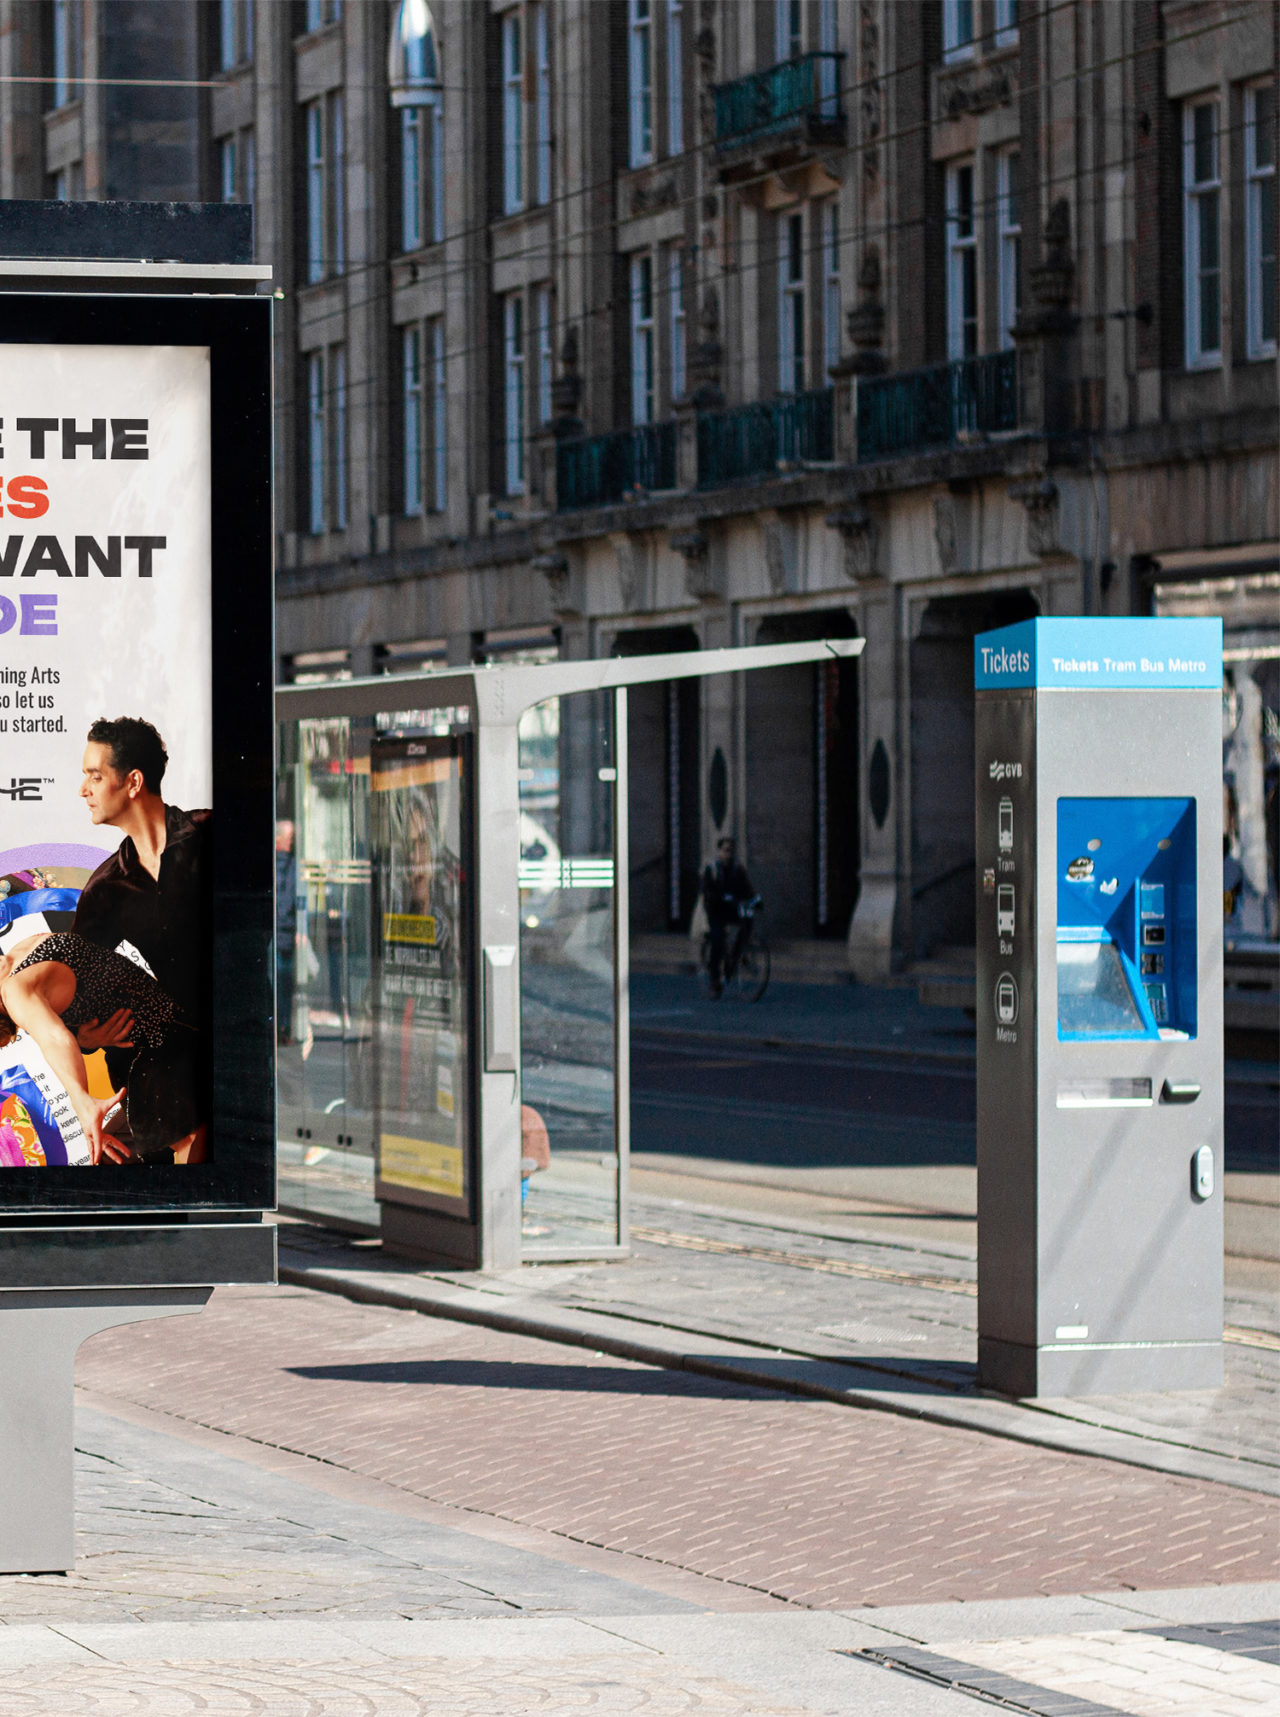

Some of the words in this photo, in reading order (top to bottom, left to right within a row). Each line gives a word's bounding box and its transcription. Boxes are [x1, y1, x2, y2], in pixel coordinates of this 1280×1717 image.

[16, 418, 149, 460] THE
[981, 647, 1029, 674] Tickets
[1052, 658, 1099, 672] Tickets
[1103, 658, 1137, 672] Tram
[1141, 658, 1164, 672] Bus
[1169, 658, 1207, 672] Metro
[31, 666, 60, 684] Arts
[15, 691, 34, 709] let
[38, 695, 54, 709] us
[13, 715, 67, 733] started.
[1006, 762, 1023, 778] GVB
[997, 858, 1015, 873] Tram
[1000, 939, 1013, 955] Bus
[997, 1027, 1017, 1043] Metro
